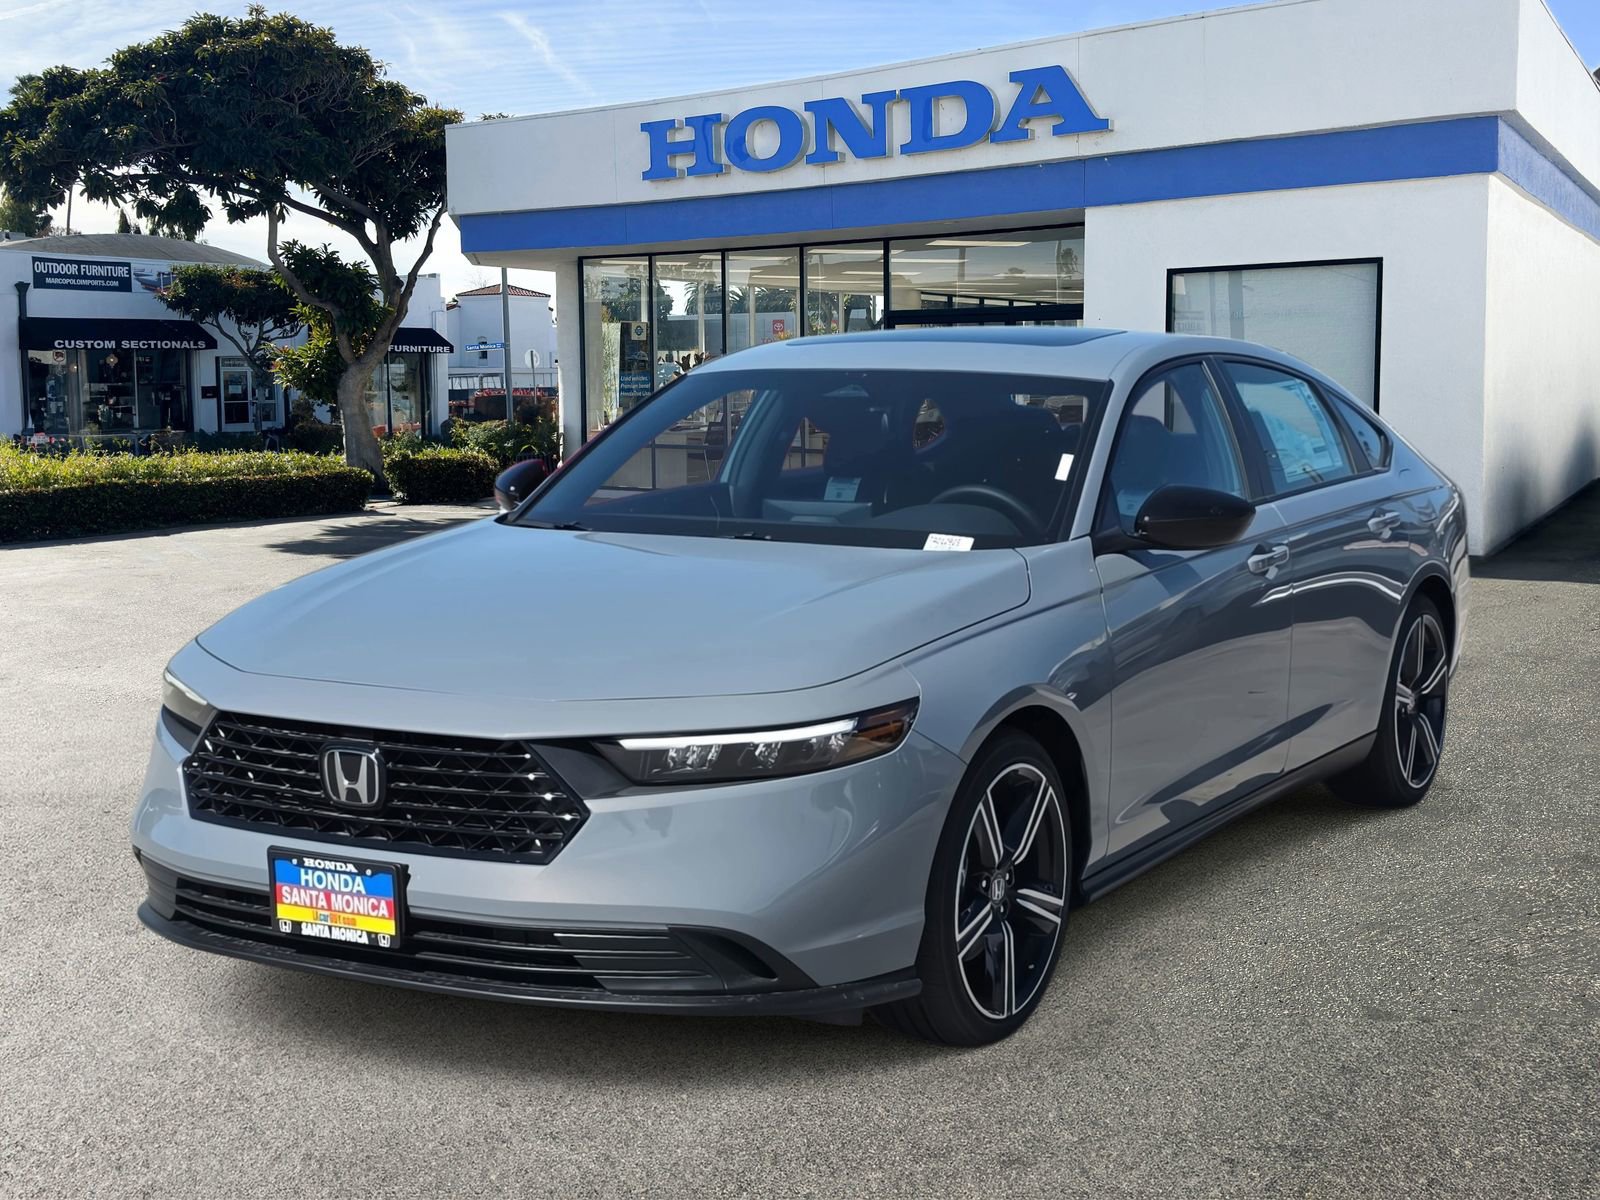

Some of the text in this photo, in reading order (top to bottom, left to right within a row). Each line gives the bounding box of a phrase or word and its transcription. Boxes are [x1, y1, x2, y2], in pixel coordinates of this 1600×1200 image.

[641, 65, 1112, 181] HONDA
[34, 261, 130, 277] OUTDOOR FURNITURE
[45, 277, 119, 287] MARCOPOLOIMPORTS.COM
[54, 339, 206, 349] CUSTOM SECTIONALS
[388, 344, 450, 353] FURNITURE
[303, 857, 358, 873] HONDA
[300, 869, 366, 894] HONDA
[281, 886, 389, 917] SANTA MONICA
[301, 922, 369, 945] SANTA MONICA
